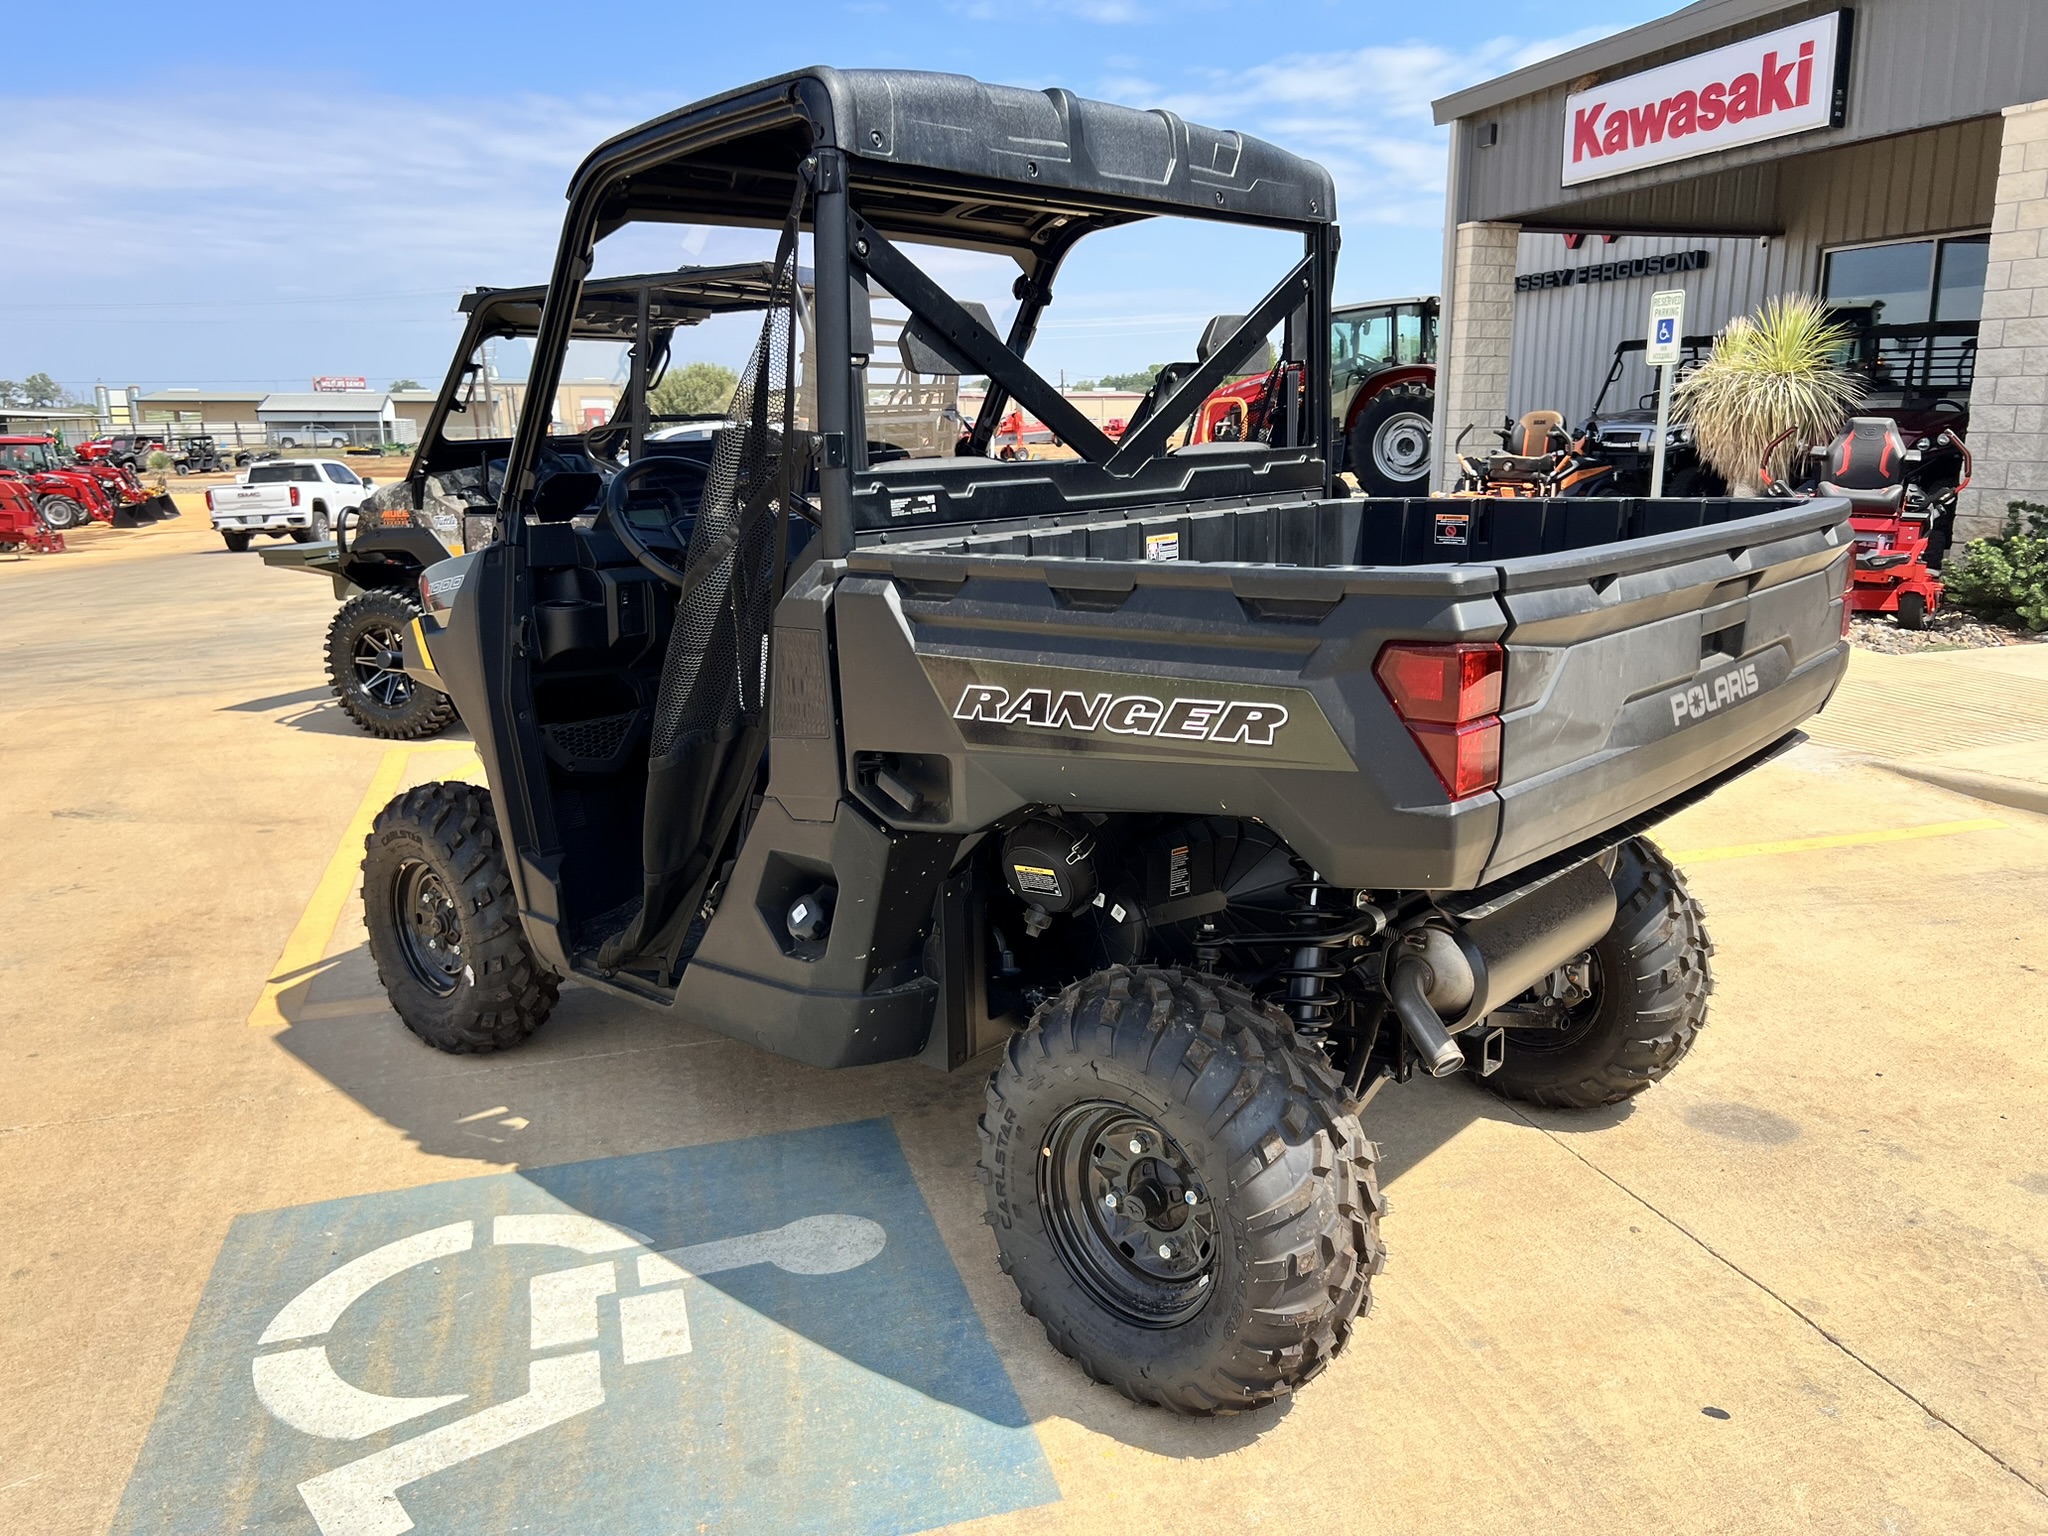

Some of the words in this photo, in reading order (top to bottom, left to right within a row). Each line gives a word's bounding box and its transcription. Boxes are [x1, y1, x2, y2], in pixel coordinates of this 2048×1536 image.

[1572, 40, 1815, 163] Kawasaki
[1576, 250, 1704, 284] FERGUSON
[1654, 296, 1681, 306] RESERVED
[1655, 307, 1679, 317] PARKING
[381, 509, 411, 518] MULE
[953, 684, 1289, 746] RANGER
[1670, 663, 1759, 727] POLARIS
[994, 1107, 1017, 1230] CARLSTAR
